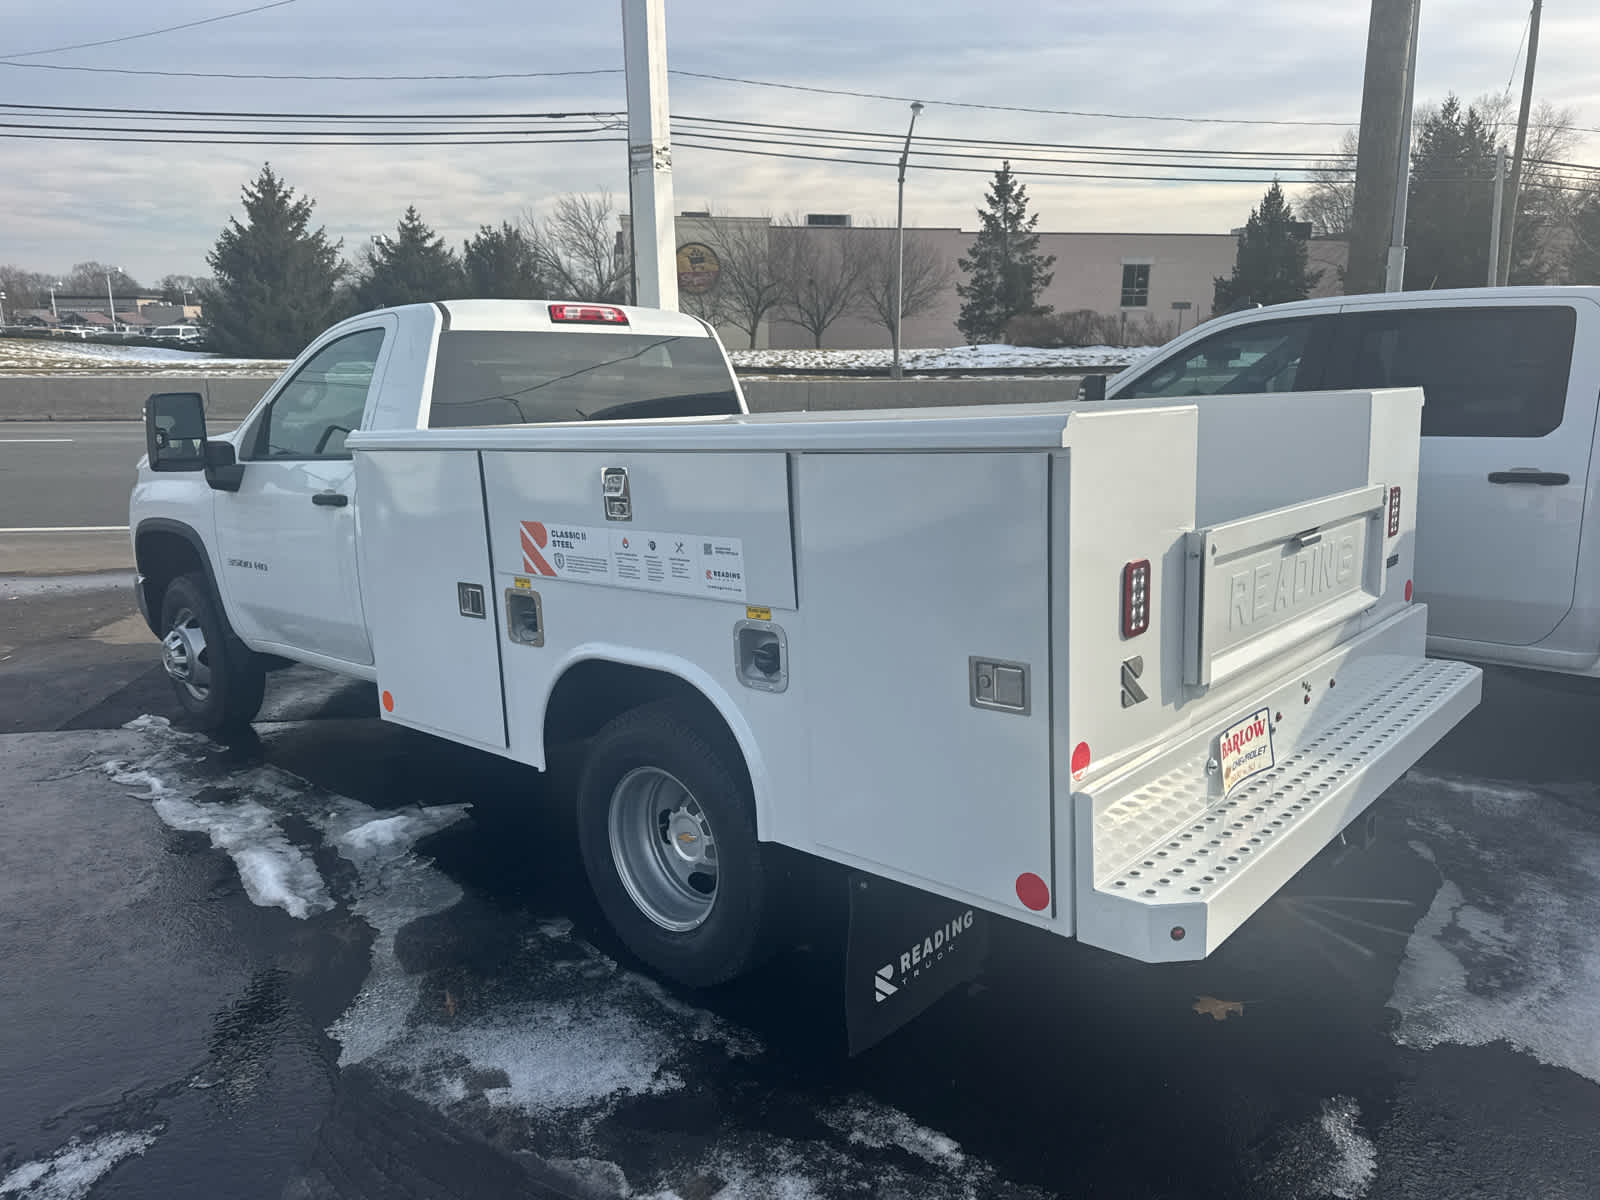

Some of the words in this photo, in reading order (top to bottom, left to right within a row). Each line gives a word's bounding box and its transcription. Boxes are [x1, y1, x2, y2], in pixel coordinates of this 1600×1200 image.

[551, 529, 580, 540] CLASSIC
[551, 540, 575, 549] STEEL
[1228, 535, 1353, 632] READING
[1221, 719, 1266, 760] BARLOW
[900, 910, 974, 974] READING
